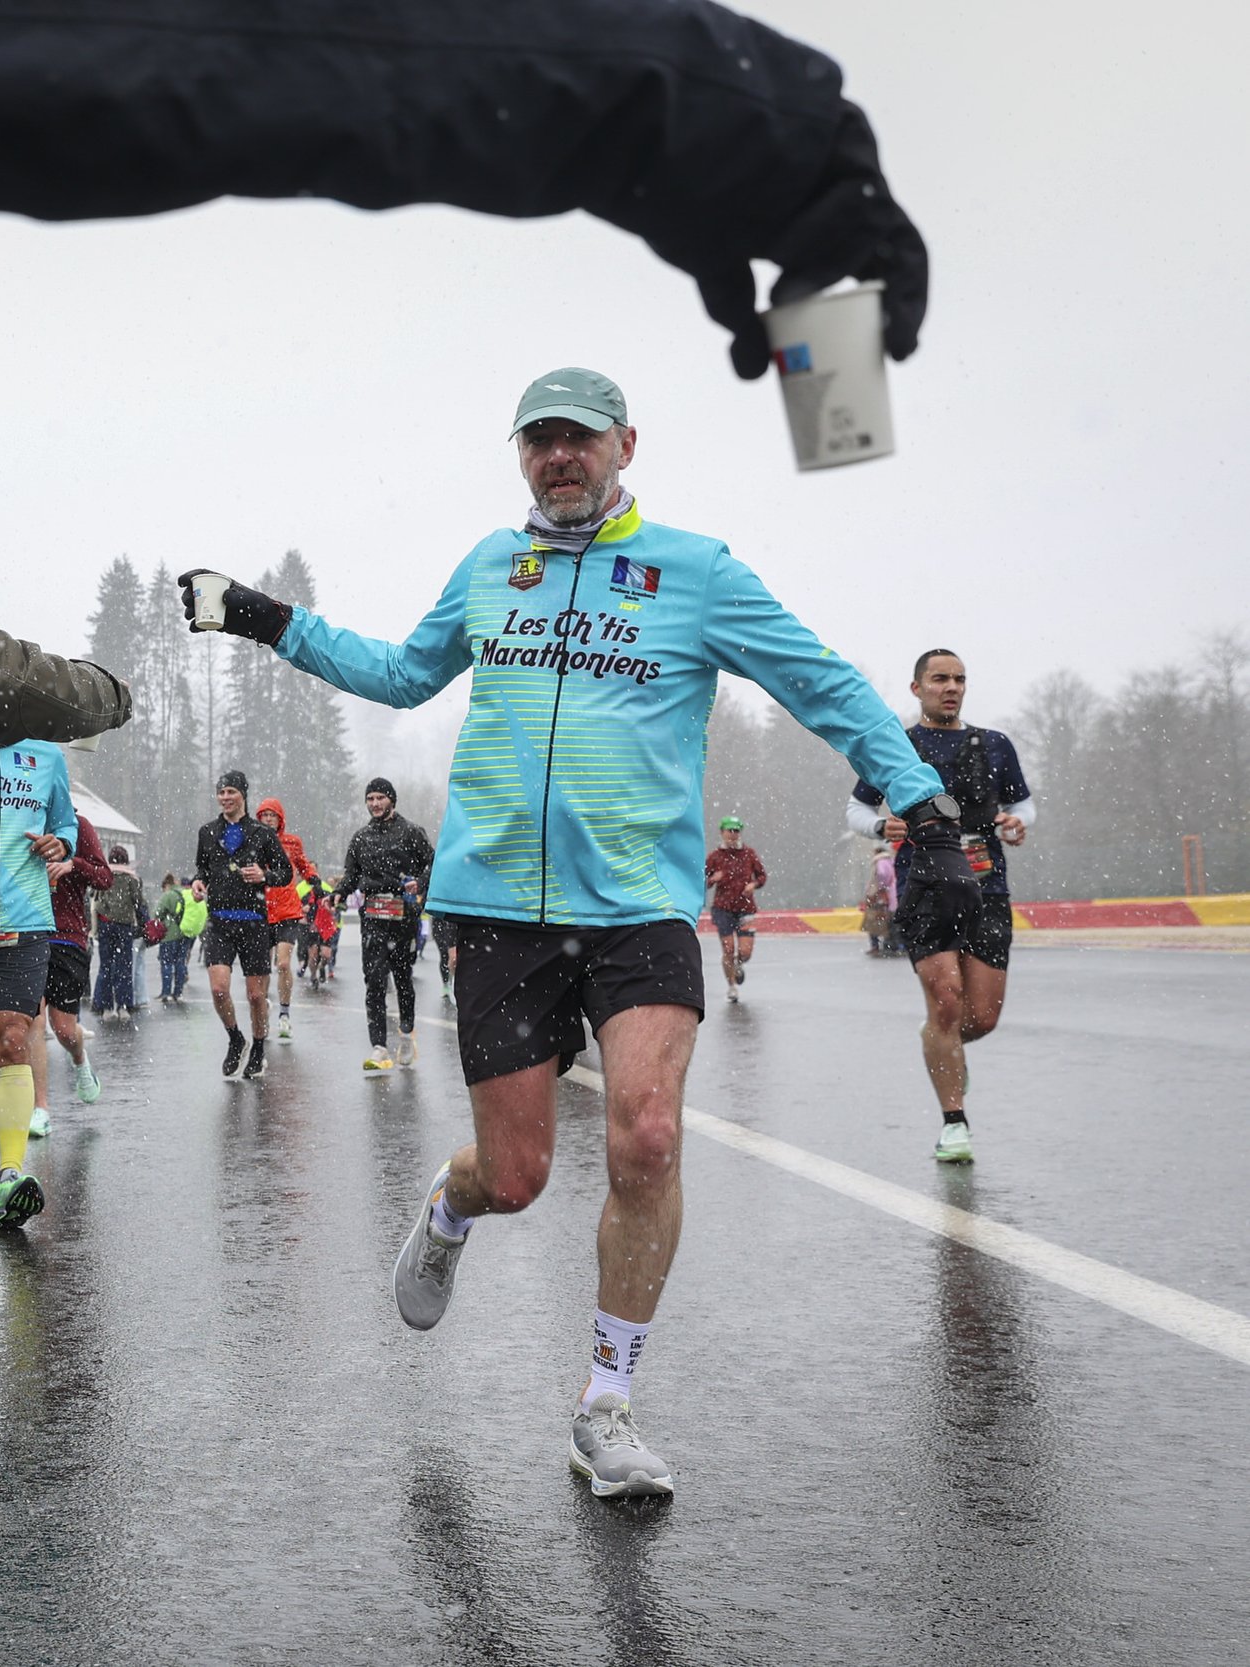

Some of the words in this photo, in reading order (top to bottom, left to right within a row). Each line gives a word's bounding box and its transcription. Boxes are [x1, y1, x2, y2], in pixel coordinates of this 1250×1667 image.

[502, 608, 549, 636] Les
[553, 608, 641, 645] Ch'tis
[479, 637, 662, 685] Marathoniens
